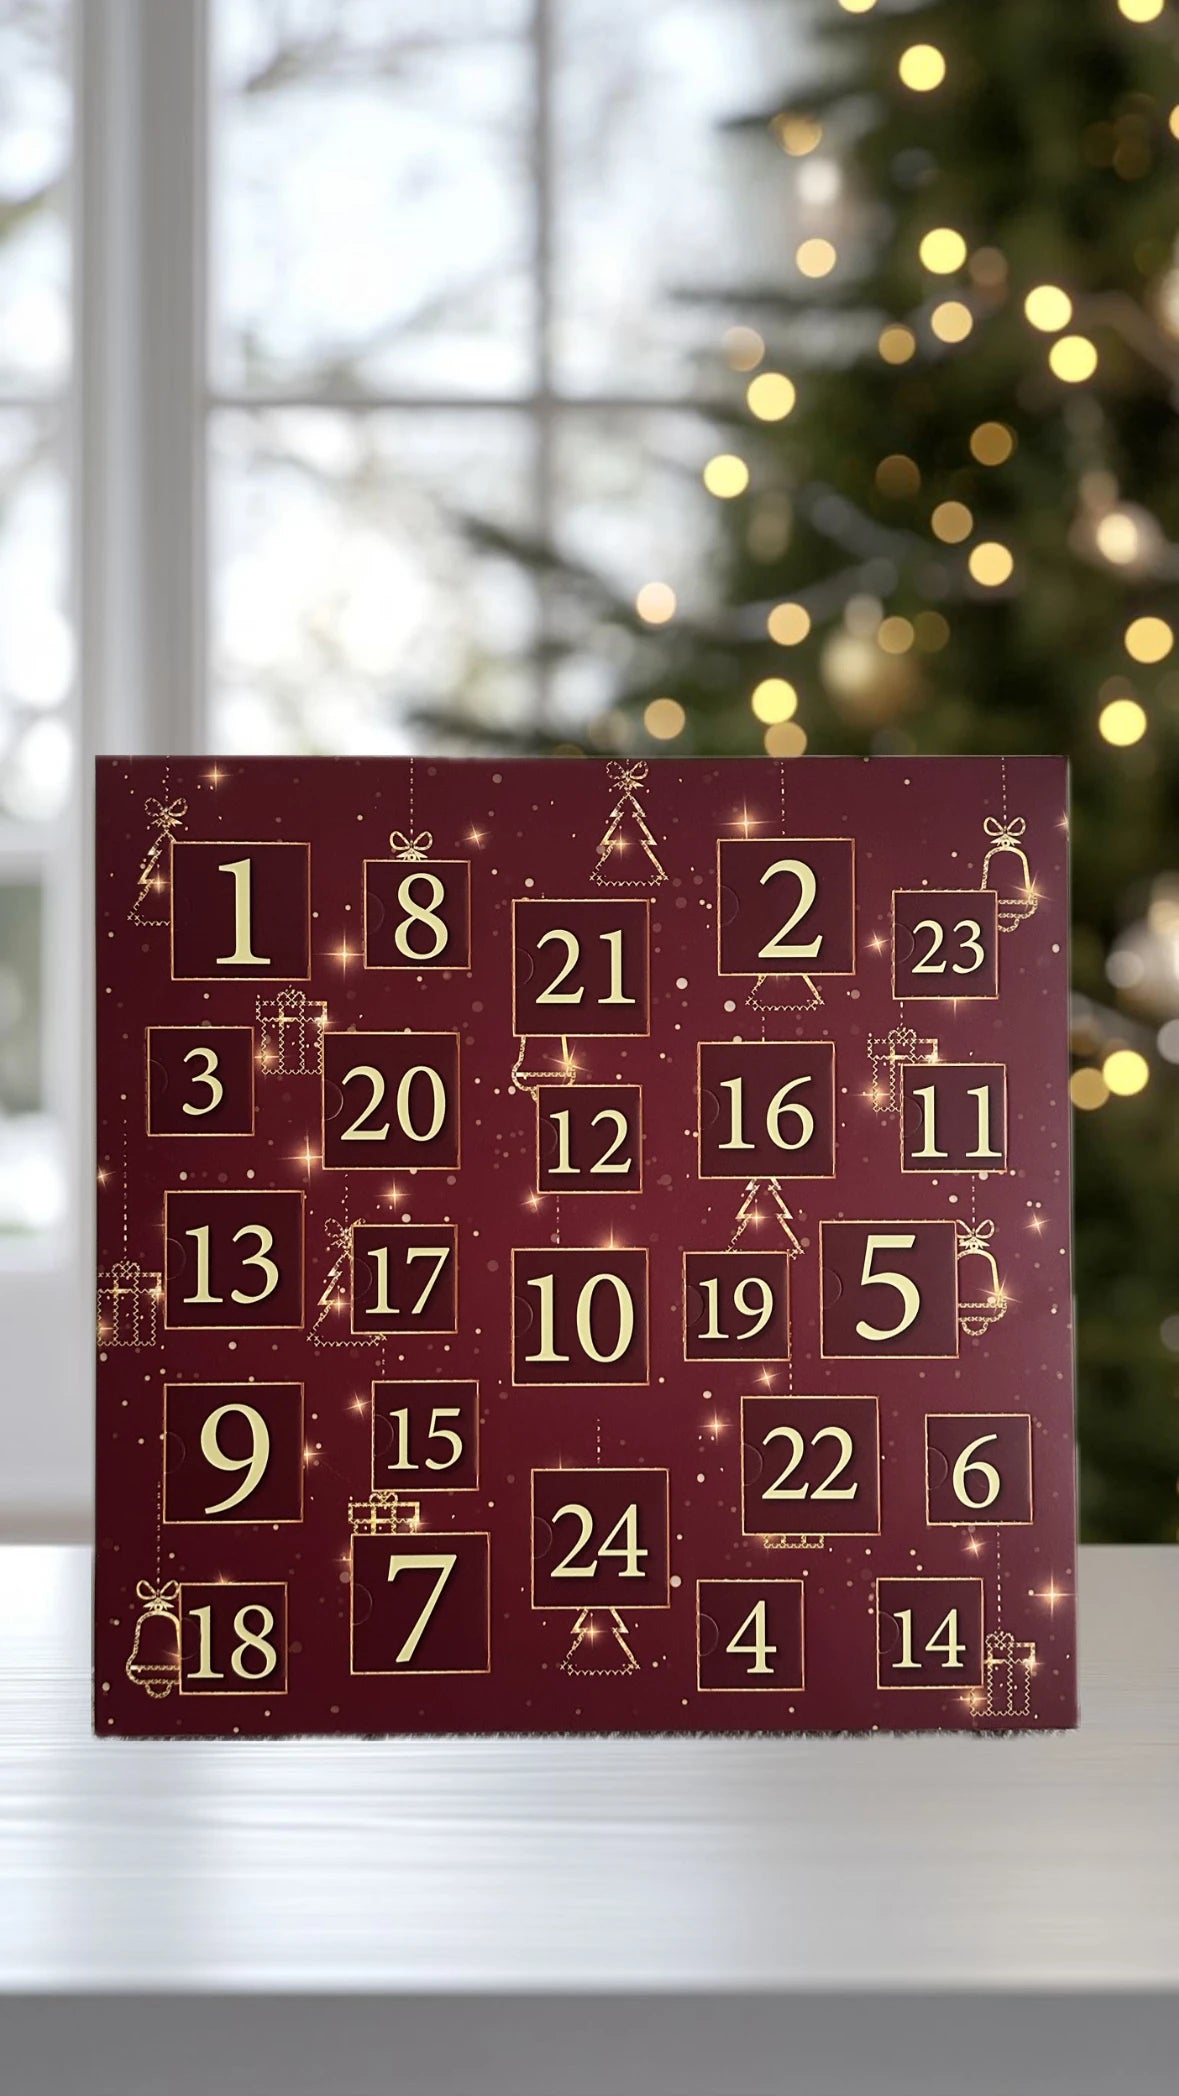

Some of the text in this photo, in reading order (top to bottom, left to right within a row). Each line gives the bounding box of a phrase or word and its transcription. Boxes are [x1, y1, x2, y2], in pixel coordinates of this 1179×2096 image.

[216, 858, 271, 965] 1
[394, 872, 448, 960] 8
[758, 859, 823, 958] 2
[535, 929, 636, 1004] 21
[911, 919, 985, 974] 23
[182, 1047, 223, 1116] 3
[340, 1065, 446, 1142] 20
[718, 1075, 814, 1150] 16
[548, 1109, 632, 1174] 12
[911, 1085, 1004, 1158] 11
[183, 1224, 279, 1304] 13
[365, 1246, 450, 1314] 17
[855, 1234, 920, 1341] 5
[524, 1273, 634, 1363] 10
[697, 1277, 773, 1340] 19
[200, 1403, 270, 1514] 9
[387, 1407, 463, 1470] 15
[761, 1426, 858, 1500] 22
[952, 1433, 1000, 1509] 6
[550, 1503, 648, 1577] 24
[187, 1604, 277, 1679] 18
[387, 1554, 457, 1663] 7
[726, 1600, 777, 1674] 4
[892, 1608, 966, 1668] 14
